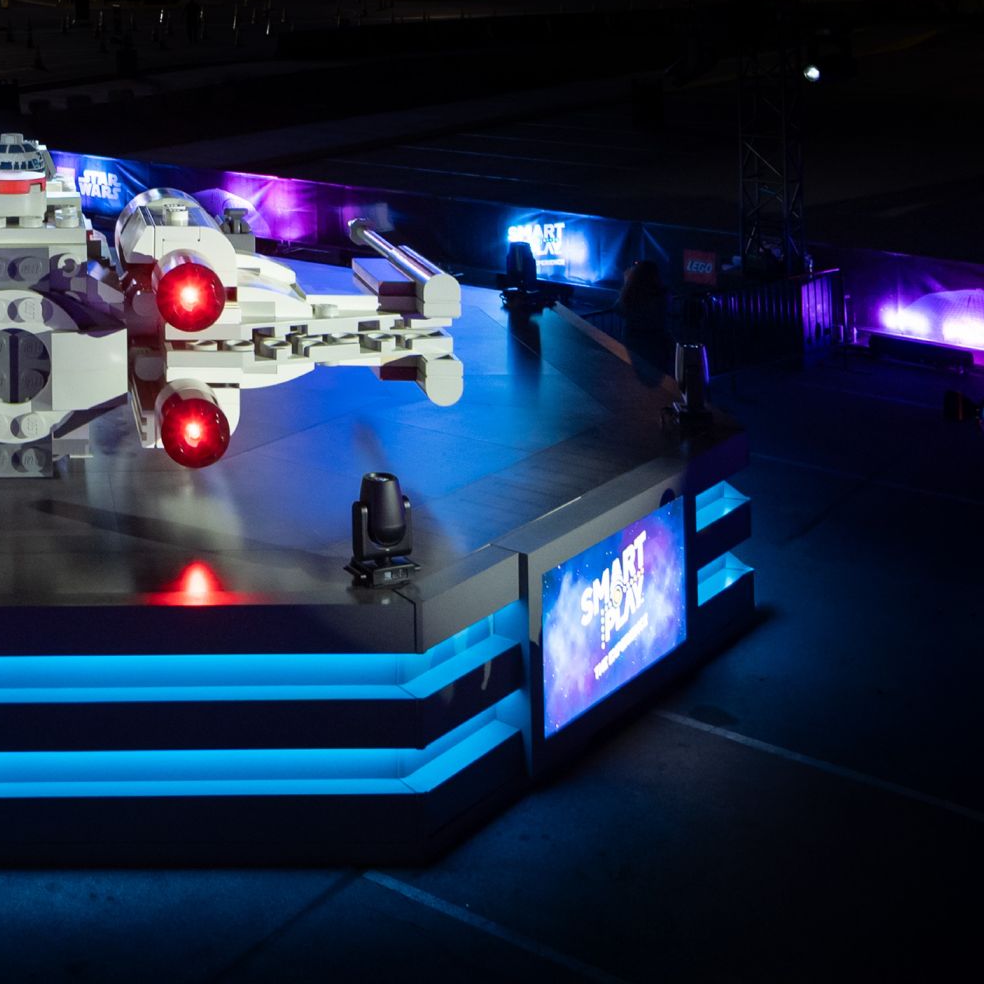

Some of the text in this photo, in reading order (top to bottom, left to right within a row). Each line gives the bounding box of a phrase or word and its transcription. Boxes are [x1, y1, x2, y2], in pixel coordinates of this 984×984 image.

[78, 169, 121, 186] STAR
[79, 182, 121, 201] WARS
[507, 222, 565, 243] SMART
[687, 260, 713, 274] LEGO
[580, 530, 647, 627] SMART
[604, 576, 645, 643] PLAY
